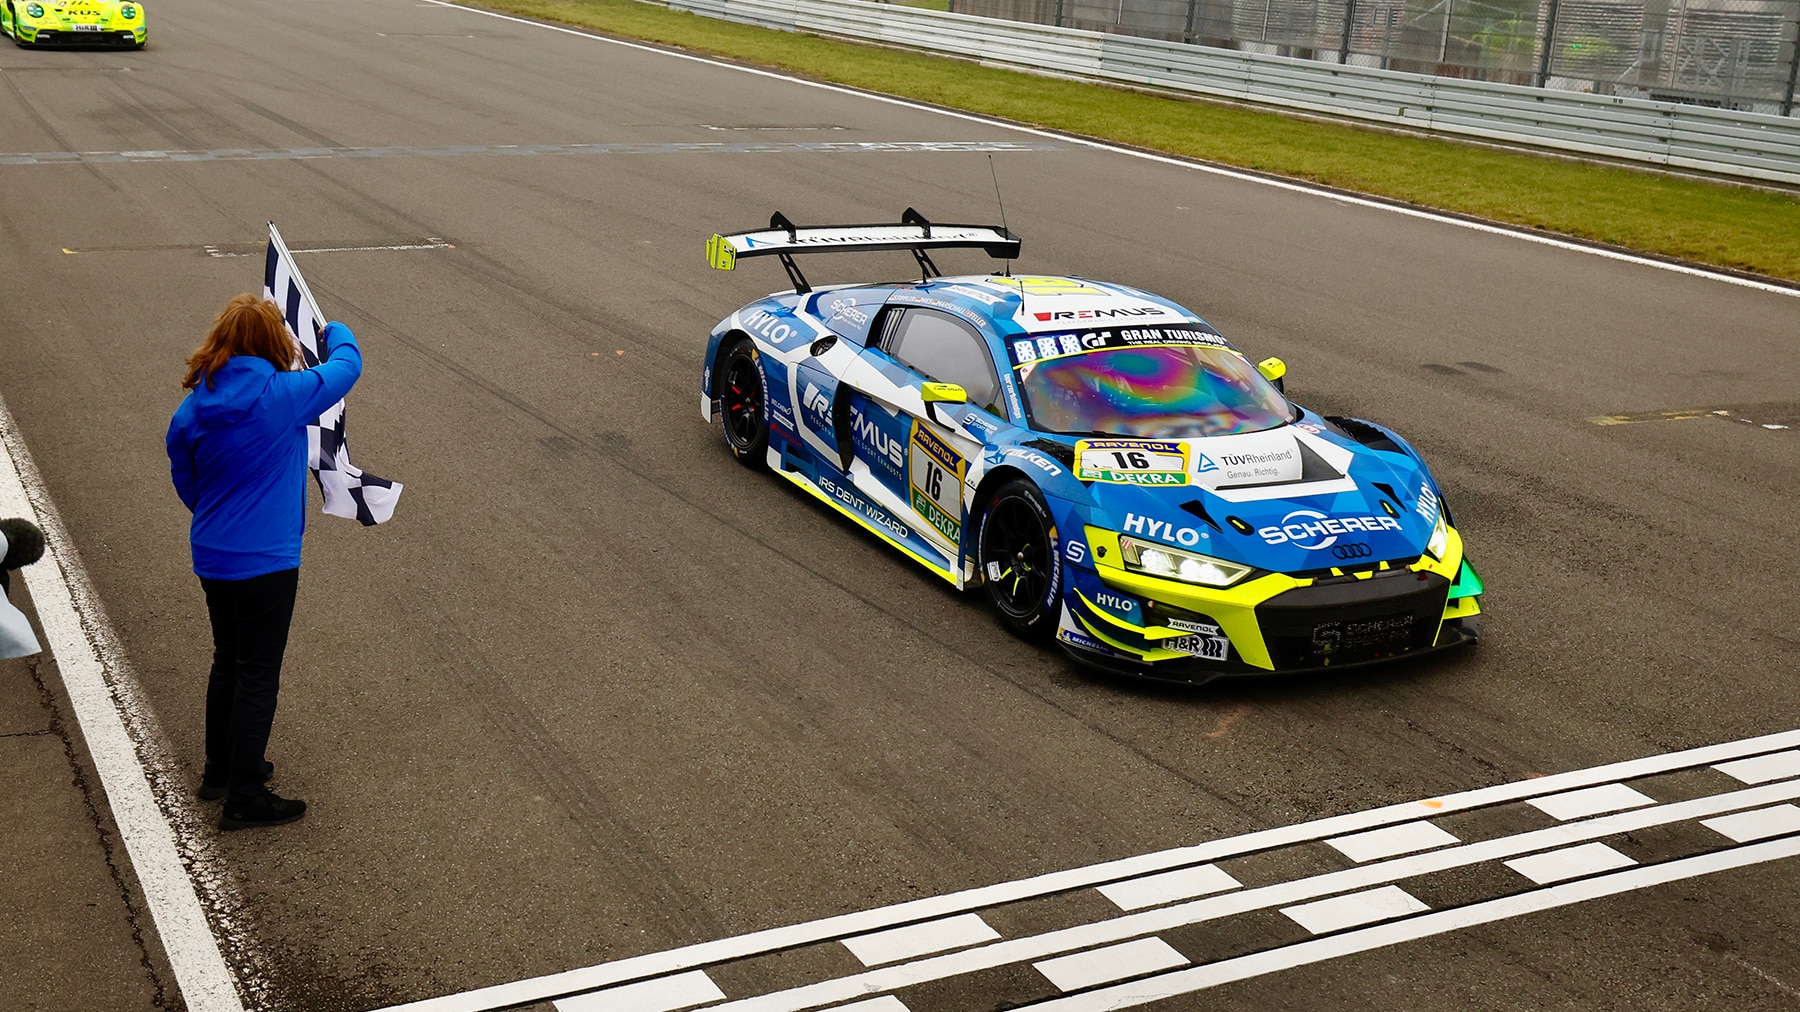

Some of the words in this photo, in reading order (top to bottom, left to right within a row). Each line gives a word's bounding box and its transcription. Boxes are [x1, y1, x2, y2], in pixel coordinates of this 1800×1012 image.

[830, 299, 868, 325] SCHERER
[1054, 307, 1165, 320] REMUS
[1121, 329, 1163, 341] GRAN
[757, 365, 770, 421] MICHELIN
[917, 429, 955, 467] RAVENOL
[1093, 441, 1175, 452] RAVENOL
[1111, 452, 1150, 470] 16
[925, 461, 943, 502] 16
[1109, 471, 1181, 485] DEKRA
[1227, 470, 1253, 479] Genau.
[1254, 467, 1280, 477] Richtig.
[819, 475, 835, 493] IRS
[835, 486, 865, 511] DENT
[866, 504, 909, 539] WIZARD
[928, 504, 961, 544] DEKRA
[1258, 516, 1403, 545] SCHERER
[1047, 550, 1060, 607] MICHELIN
[1172, 621, 1214, 633] RAVENOL
[1165, 636, 1202, 653] H&R
